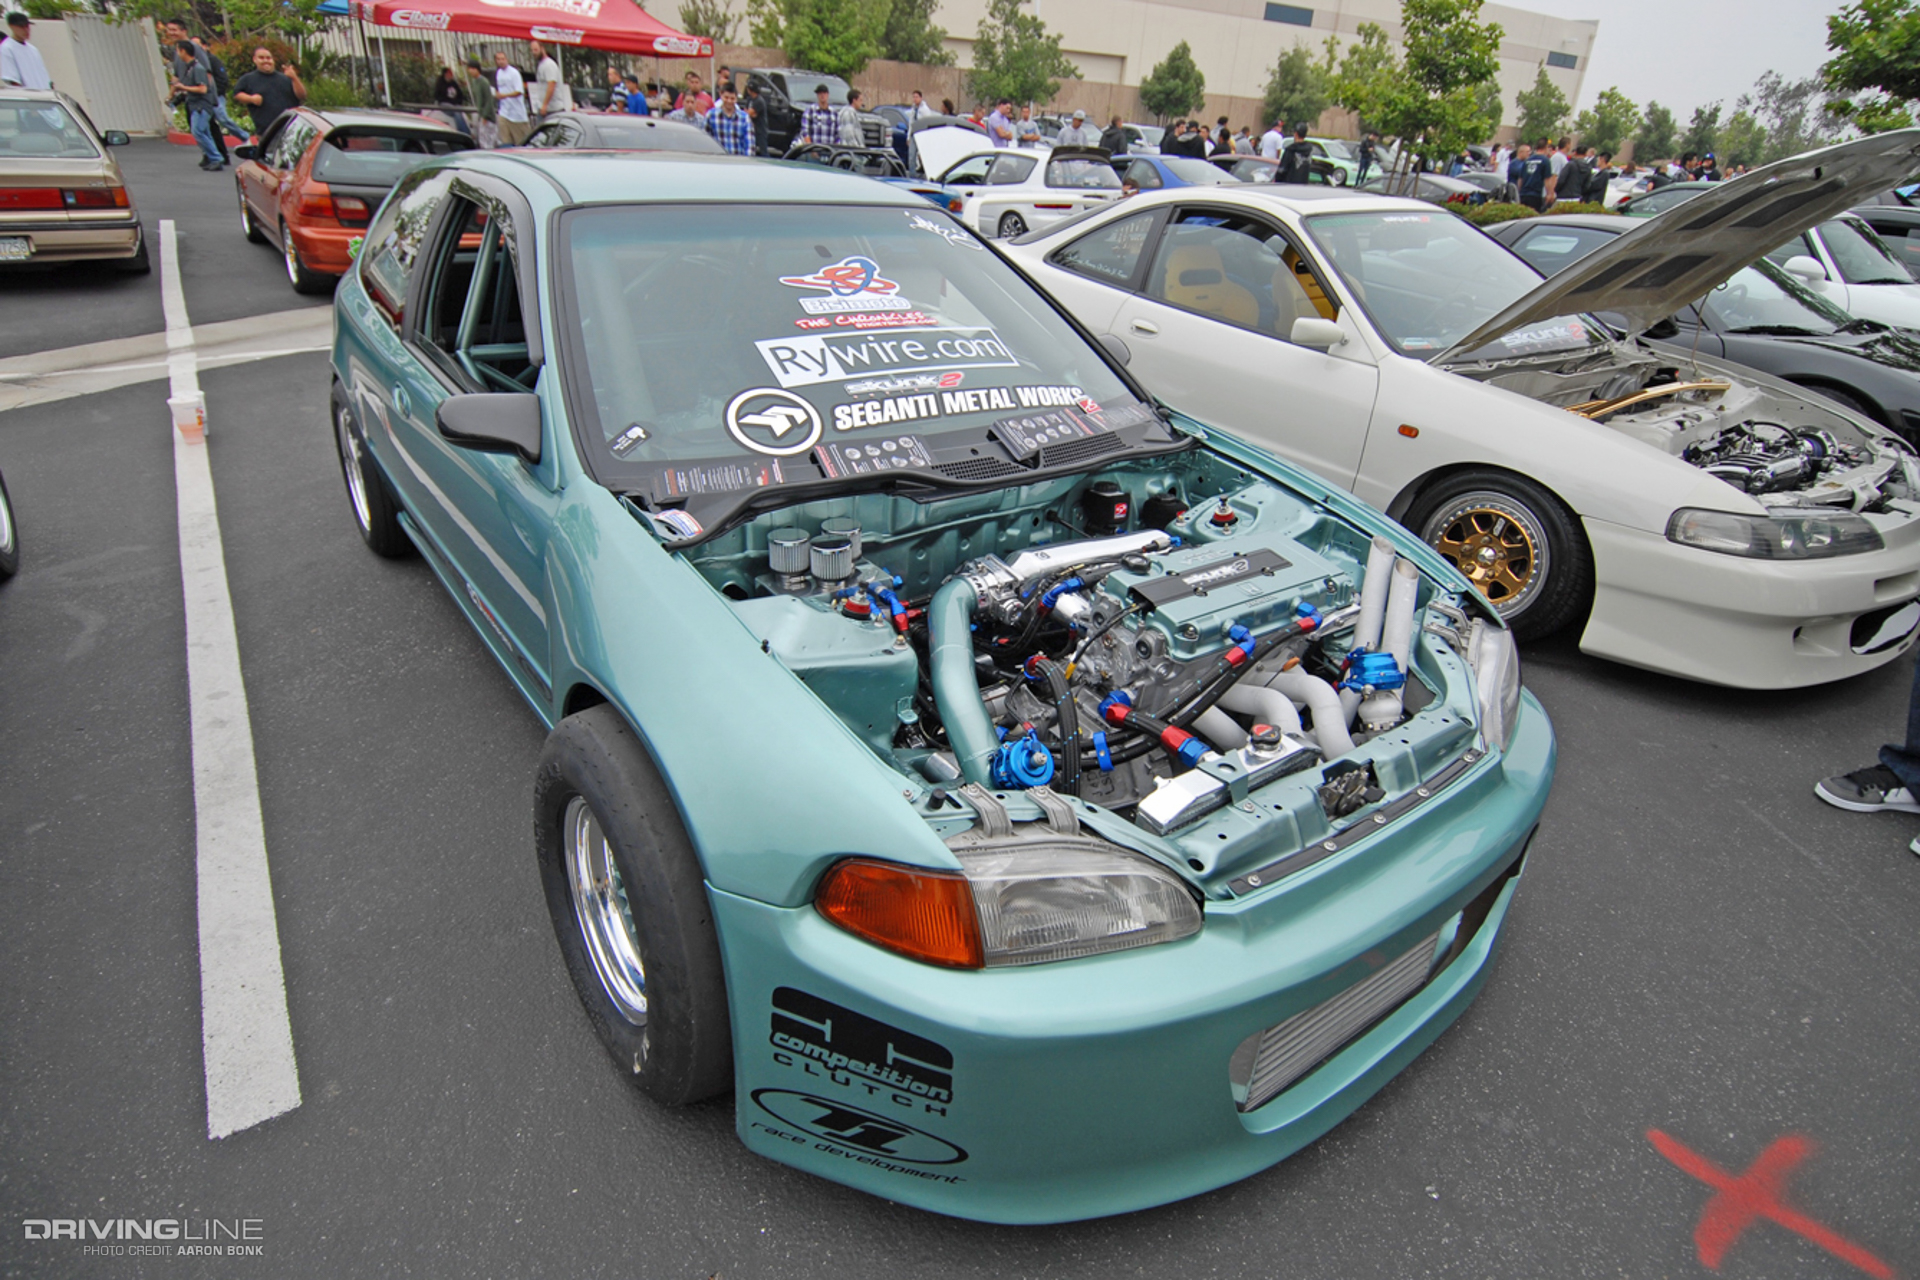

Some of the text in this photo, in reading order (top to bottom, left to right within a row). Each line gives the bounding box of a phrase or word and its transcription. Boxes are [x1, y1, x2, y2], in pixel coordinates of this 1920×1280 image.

[796, 317, 831, 330] THE
[803, 298, 908, 312] Bisimoto
[768, 335, 1007, 378] Rywire.com
[833, 394, 939, 431] SEGANTI
[942, 386, 1017, 415] METAL
[1015, 385, 1084, 408] WORKS
[771, 1030, 951, 1103] competition
[772, 1051, 948, 1118] CLUTCH
[750, 1121, 968, 1185] race development
